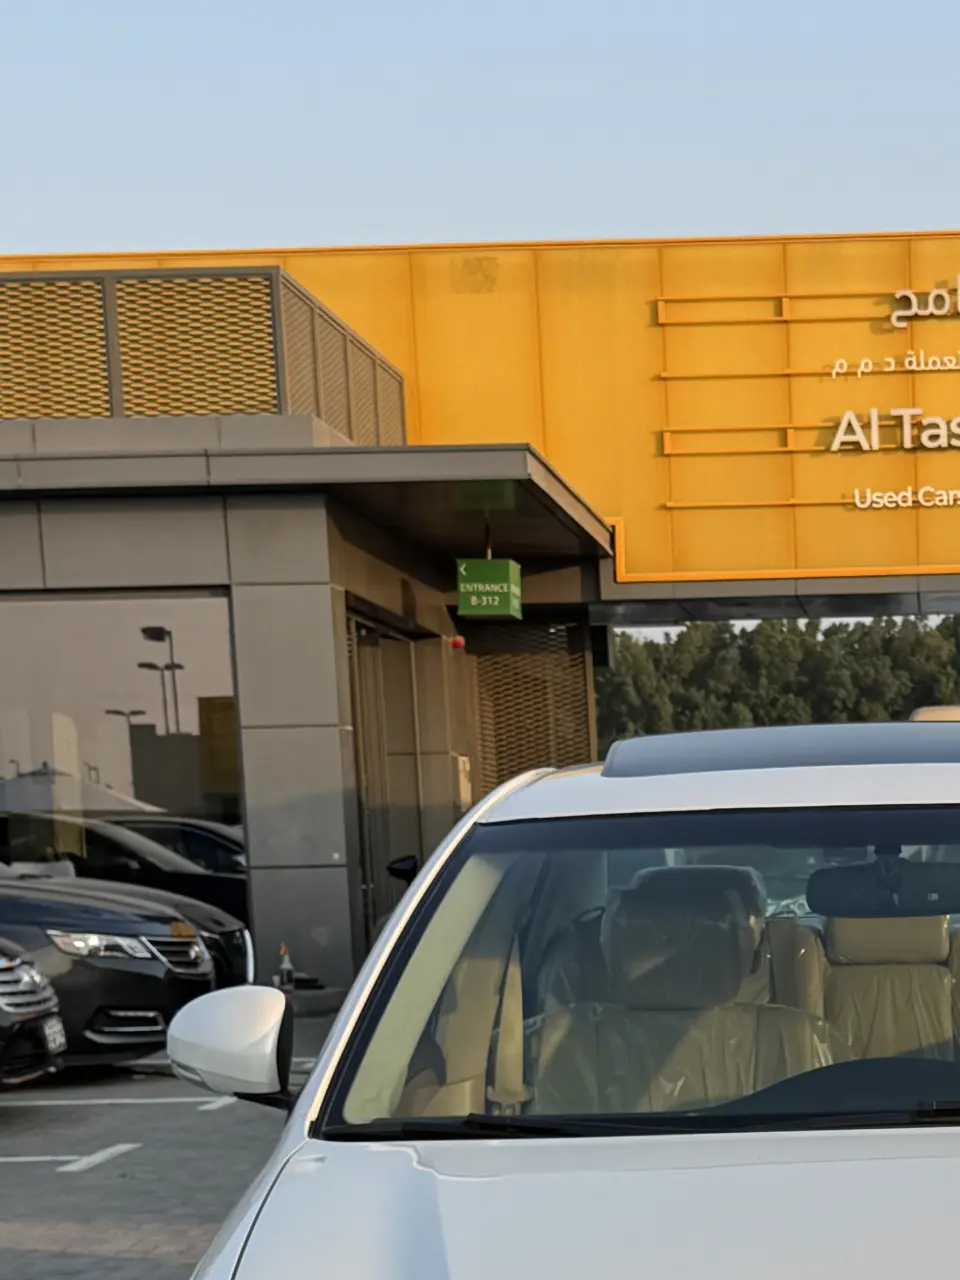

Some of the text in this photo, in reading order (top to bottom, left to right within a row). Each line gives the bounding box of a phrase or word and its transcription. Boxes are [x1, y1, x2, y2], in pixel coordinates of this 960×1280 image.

[831, 359, 848, 378] م
[857, 358, 873, 378] م
[831, 408, 879, 451] Al
[854, 488, 913, 509] Used
[460, 583, 509, 592] ENTRANCE
